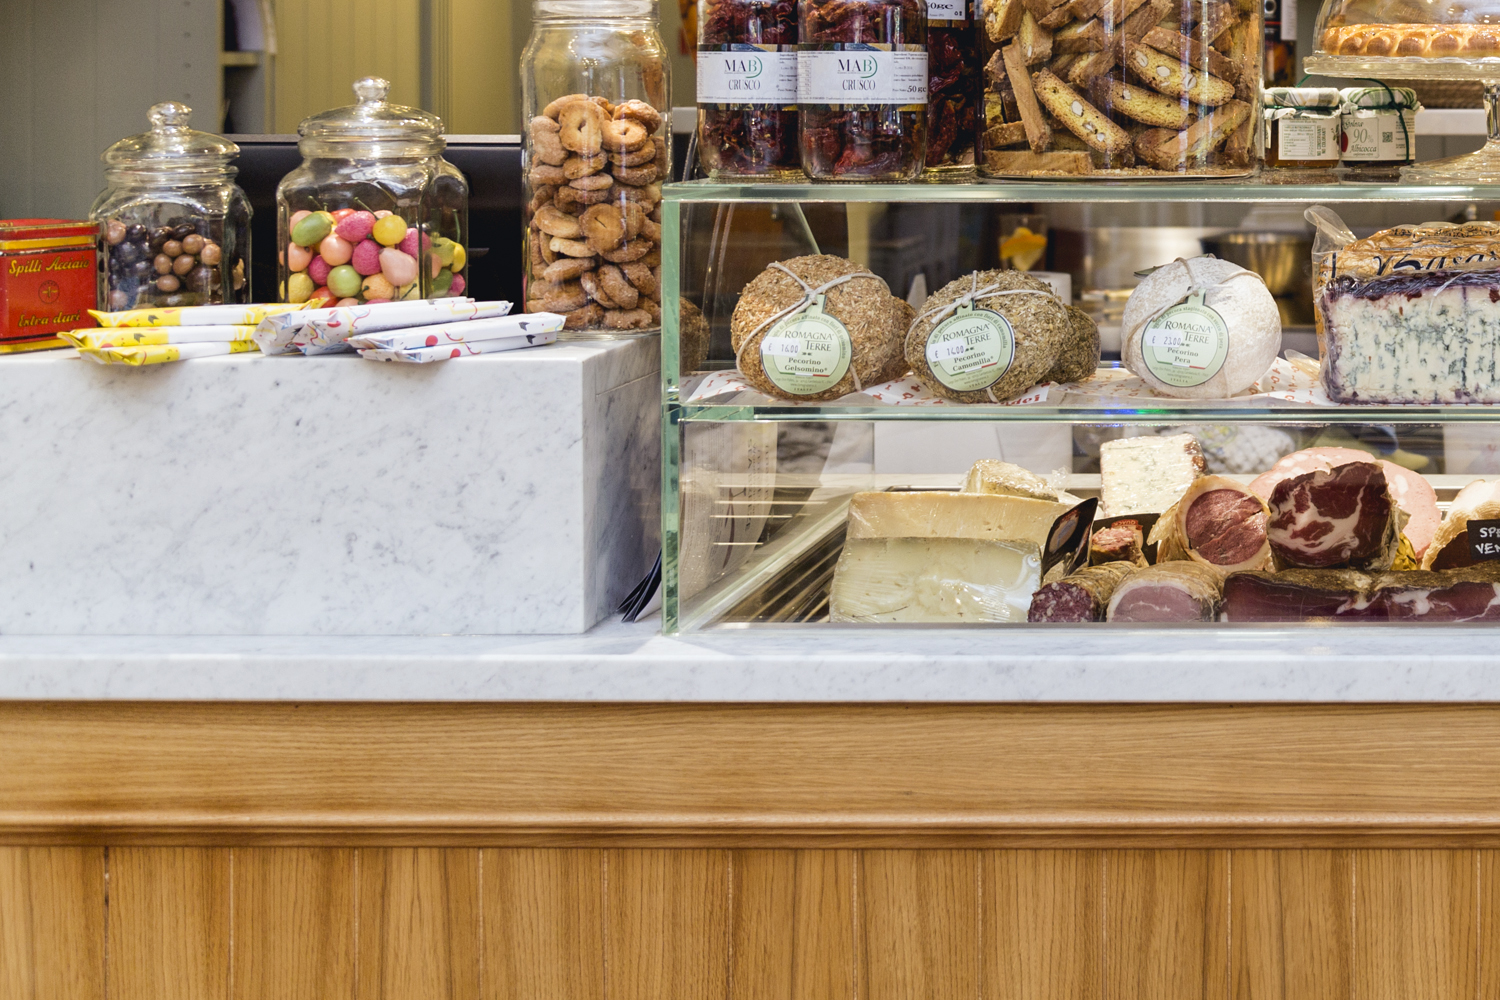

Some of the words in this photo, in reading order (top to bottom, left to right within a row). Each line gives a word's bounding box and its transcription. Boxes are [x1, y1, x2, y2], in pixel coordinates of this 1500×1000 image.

[728, 79, 761, 91] CRUSCO
[842, 79, 876, 91] CRUSCO
[8, 259, 43, 277] Spilli
[45, 256, 90, 271] Acciaio
[18, 314, 49, 327] Extra
[52, 310, 81, 324] duri
[942, 323, 990, 342] ROMAGNA
[1164, 320, 1211, 334] ROMAGNA
[784, 330, 832, 341] ROMAGNA
[964, 333, 991, 345] TERRE
[1184, 332, 1209, 344] TERRE
[806, 340, 832, 351] TERRE
[954, 351, 985, 363] Pecorino
[1167, 347, 1199, 357] Pecorino
[788, 357, 821, 365] Pecorino
[952, 357, 991, 372] Camomilla
[1174, 355, 1191, 364] Pera
[784, 364, 825, 373] Gelsomino
